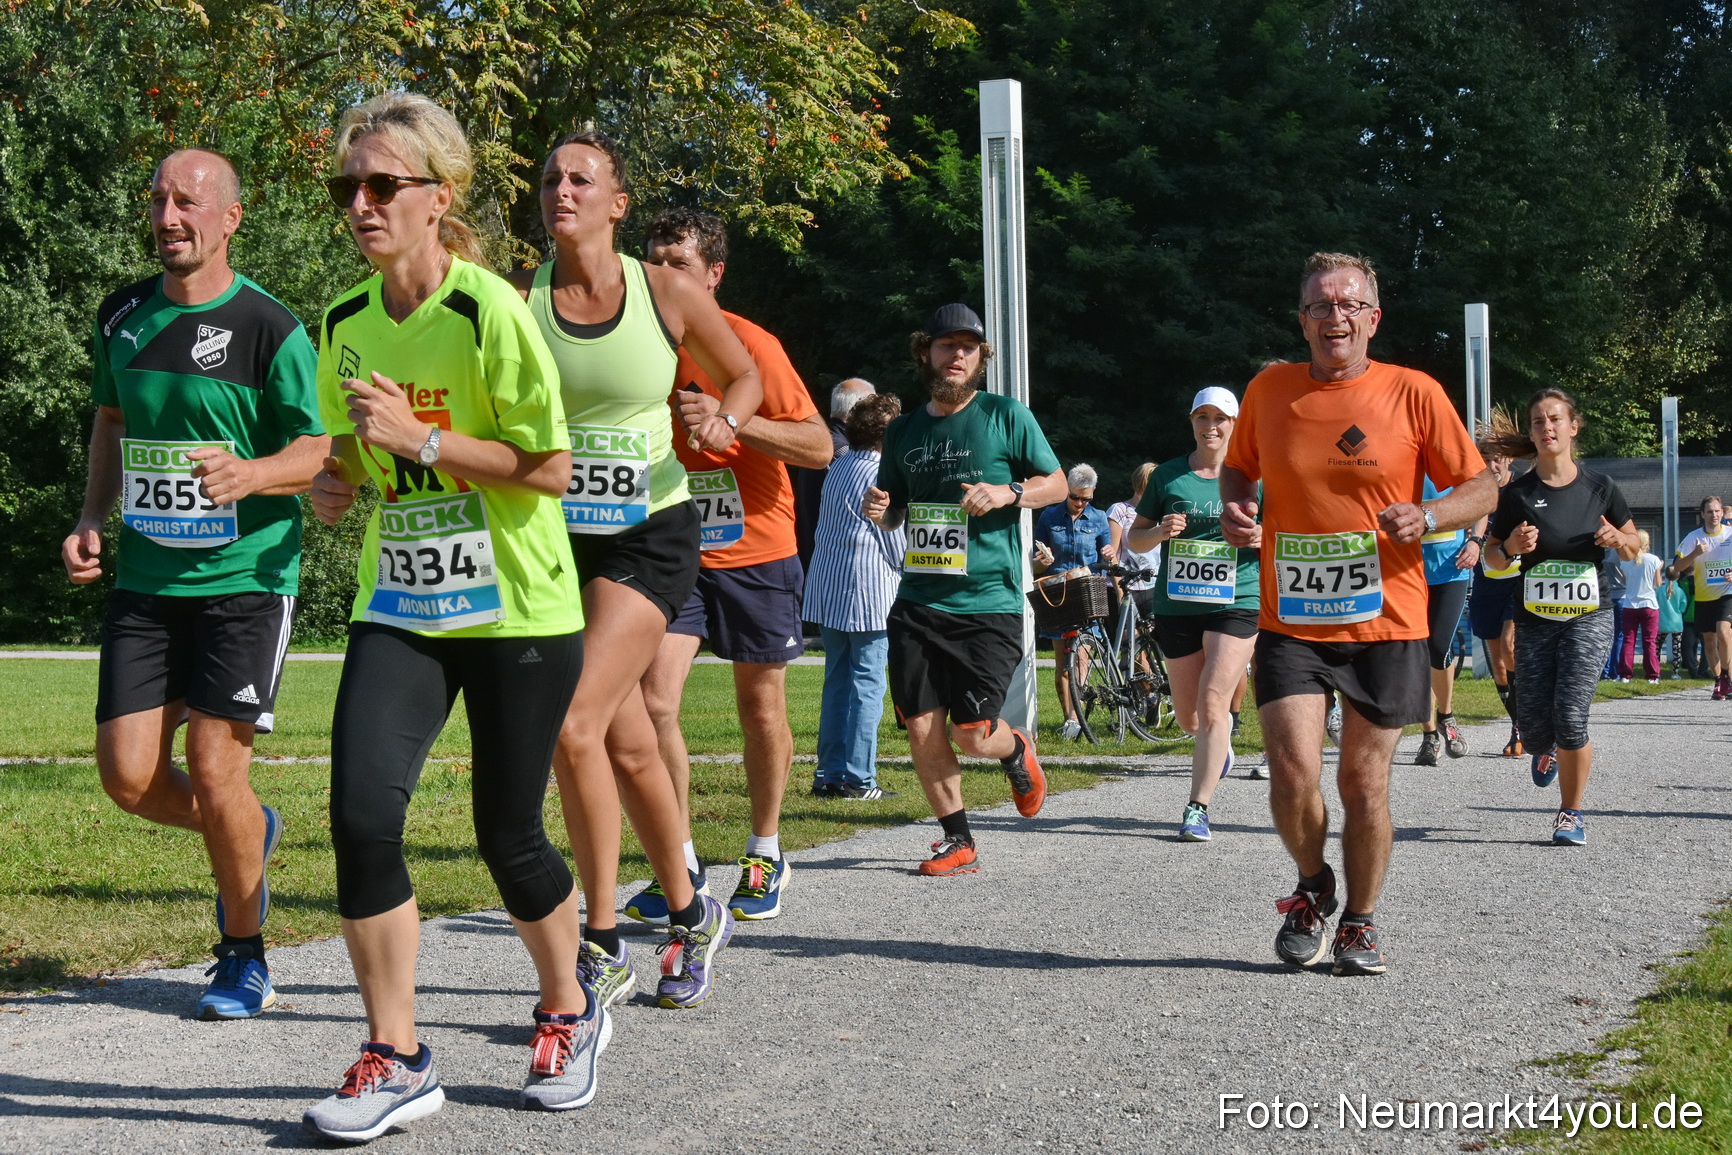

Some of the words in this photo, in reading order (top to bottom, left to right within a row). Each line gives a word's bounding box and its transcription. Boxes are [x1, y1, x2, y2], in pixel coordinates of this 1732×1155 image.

[200, 327, 216, 338] SV
[196, 337, 226, 354] POLLING
[202, 352, 221, 364] 1950
[380, 382, 449, 408] ler
[570, 430, 639, 456] OCK
[130, 444, 203, 469] BOC
[1327, 458, 1378, 467] FliesenEichl
[567, 464, 635, 497] 658
[688, 473, 729, 492] CK
[564, 506, 626, 522] ETTINA
[696, 498, 733, 522] 74
[911, 506, 961, 522] BOCK
[133, 520, 225, 535] CHRISTIAN
[701, 529, 723, 540] ANZ
[910, 528, 959, 550] 1046
[1283, 536, 1367, 558] BOCK
[1174, 542, 1231, 559] BOCK
[381, 543, 477, 586] 2334
[912, 556, 952, 565] BASTIAN
[1174, 560, 1228, 581] 2066
[1286, 563, 1369, 593] 2475
[1532, 563, 1587, 576] BOCK
[1178, 585, 1220, 595] SANDRA
[1534, 582, 1591, 601] 1110
[397, 595, 472, 616] MONIKA
[1304, 601, 1357, 614] FRANZ
[1535, 606, 1588, 614] STEFANIE
[233, 694, 260, 704] adidas
